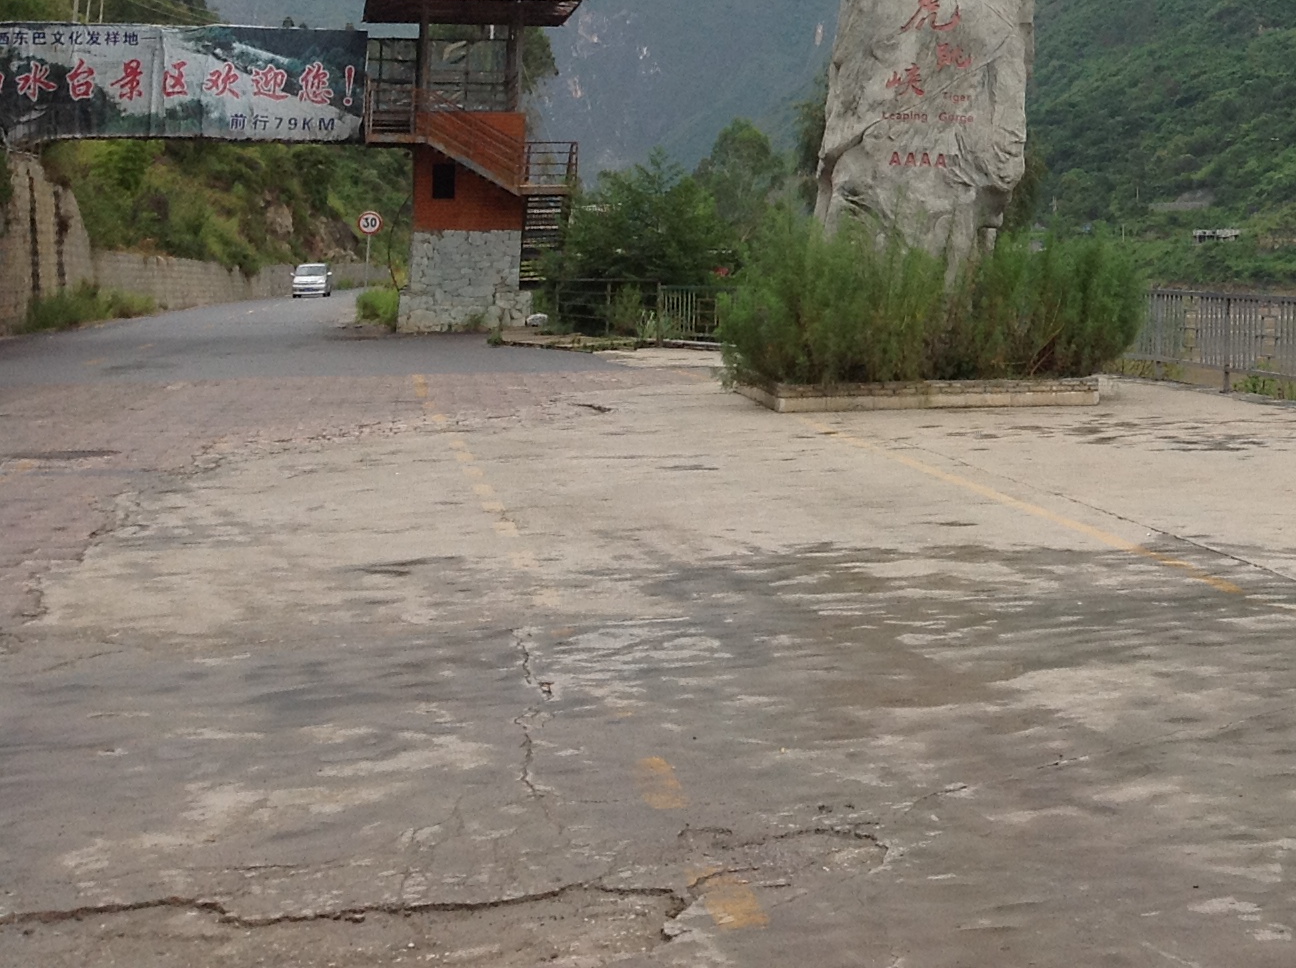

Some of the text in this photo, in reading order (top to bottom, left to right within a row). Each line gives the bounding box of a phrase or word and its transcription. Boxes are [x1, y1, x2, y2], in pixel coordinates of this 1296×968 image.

[0, 58, 356, 106] 水台景区欢迎您!
[943, 91, 972, 104] Tiger
[882, 111, 974, 124] Leaping Gorge
[362, 217, 377, 229] 30
